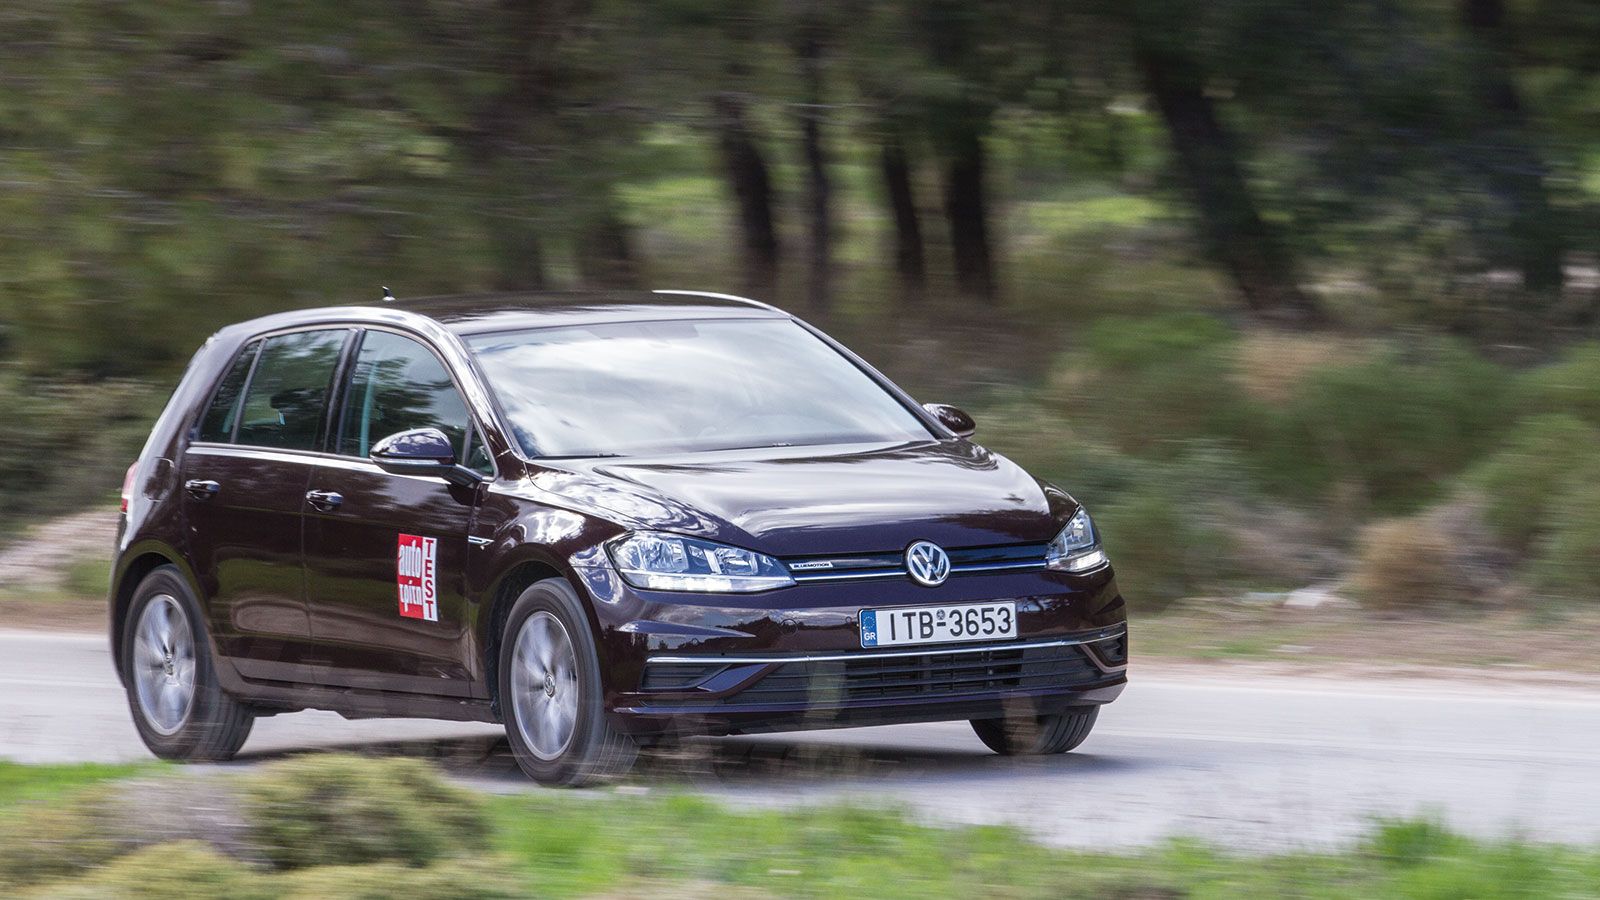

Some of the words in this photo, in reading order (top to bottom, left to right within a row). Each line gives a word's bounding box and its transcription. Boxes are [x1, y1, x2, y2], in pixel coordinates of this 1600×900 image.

[399, 539, 422, 578] auto
[425, 540, 434, 618] TEST
[863, 632, 876, 641] GR
